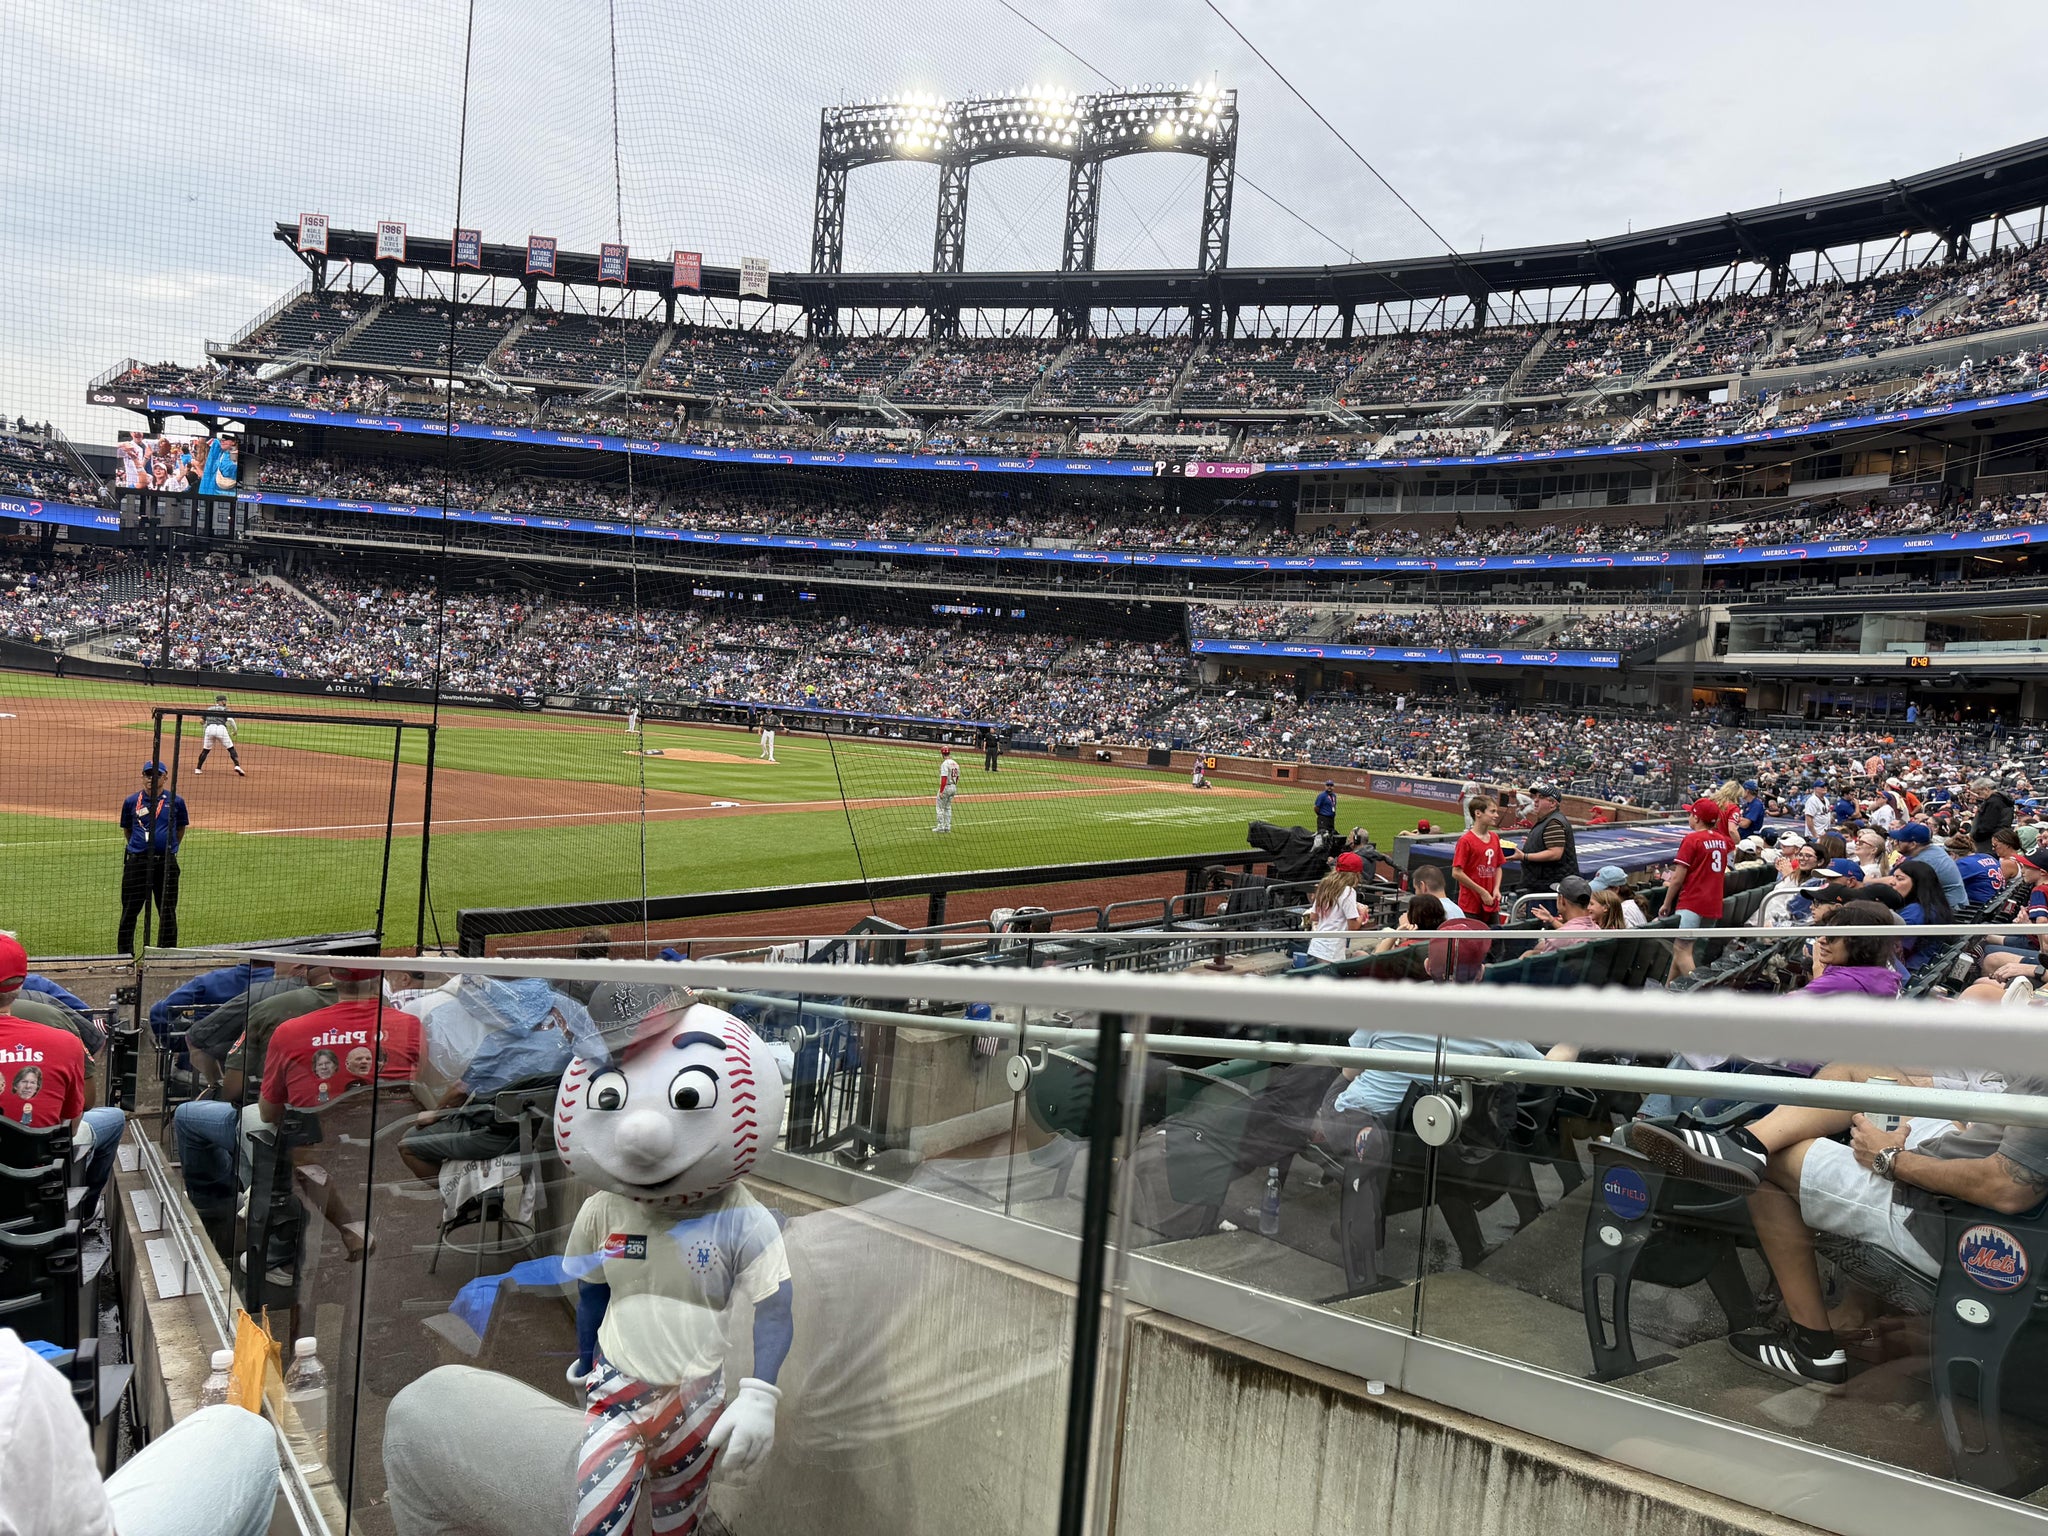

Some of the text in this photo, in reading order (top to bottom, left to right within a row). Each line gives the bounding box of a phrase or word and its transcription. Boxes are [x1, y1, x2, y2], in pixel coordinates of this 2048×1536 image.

[304, 217, 324, 227] 1969
[382, 225, 402, 235] 1986
[457, 253, 478, 261] HAMPIONS
[93, 395, 116, 403] 6:29
[1923, 407, 1945, 415] AMERICA
[1977, 399, 1999, 407] AMERICA
[151, 400, 179, 408] AMERICA
[289, 412, 316, 420] AMERICA
[355, 418, 383, 426] AMERICA
[491, 430, 517, 438] AMERICA
[557, 436, 584, 444] AMERICA
[691, 449, 717, 457] AMERICA
[998, 461, 1025, 469] AMERICA
[1172, 465, 1180, 473] 2
[1221, 466, 1235, 474] TOP
[0, 502, 26, 513] RICA
[1632, 555, 1660, 563] AMERICA
[1761, 549, 1789, 557] AMERICA
[1827, 545, 1858, 553] AMERICA
[1903, 540, 1934, 548] AMERICA
[1981, 534, 2010, 543] AMERICA
[335, 684, 366, 694] DELTA
[1485, 848, 1495, 865] P
[1711, 850, 1722, 872] 3
[1196, 1131, 1202, 1141] 2
[1604, 1181, 1646, 1202] citi FIELD
[626, 1244, 644, 1255] 250
[1968, 1246, 2016, 1275] Mets
[1968, 1306, 1976, 1316] 5
